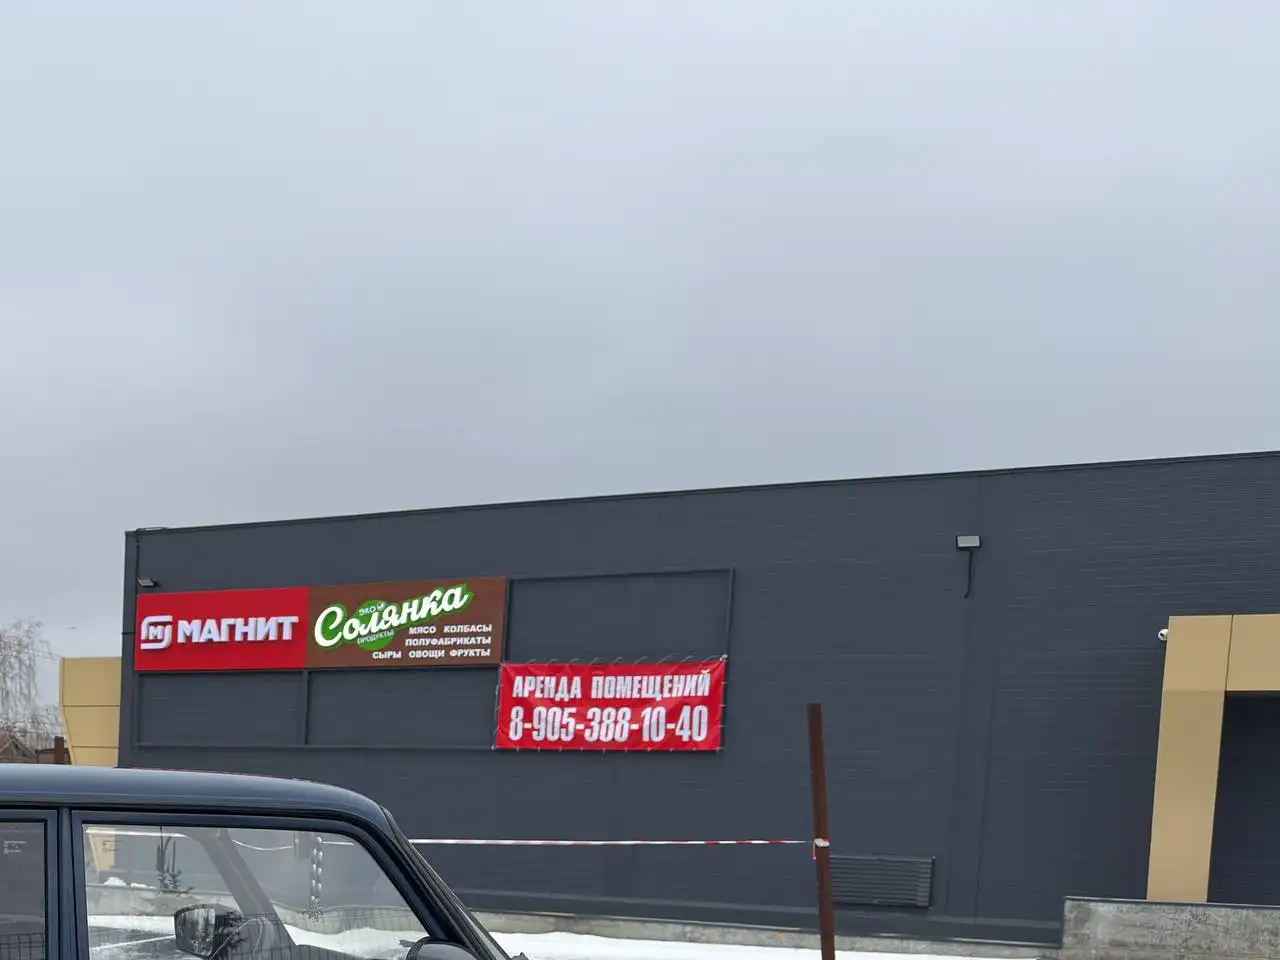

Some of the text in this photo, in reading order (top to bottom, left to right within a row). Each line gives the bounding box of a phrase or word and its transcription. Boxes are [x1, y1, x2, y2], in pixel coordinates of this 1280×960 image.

[177, 616, 299, 643] МАГНИТ
[314, 586, 468, 647] Солянка
[408, 624, 492, 635] МЯСО КОЛБАСЫ
[372, 648, 491, 660] СЫРЫ ОВОЩИ ФРУКТЫ
[405, 636, 491, 646] ПОЛУФАБРИКАТЫ
[512, 669, 711, 701] АРЕНДА ПОМЕЩЕНИЙ
[508, 704, 709, 742] 8-905-388-10-40
